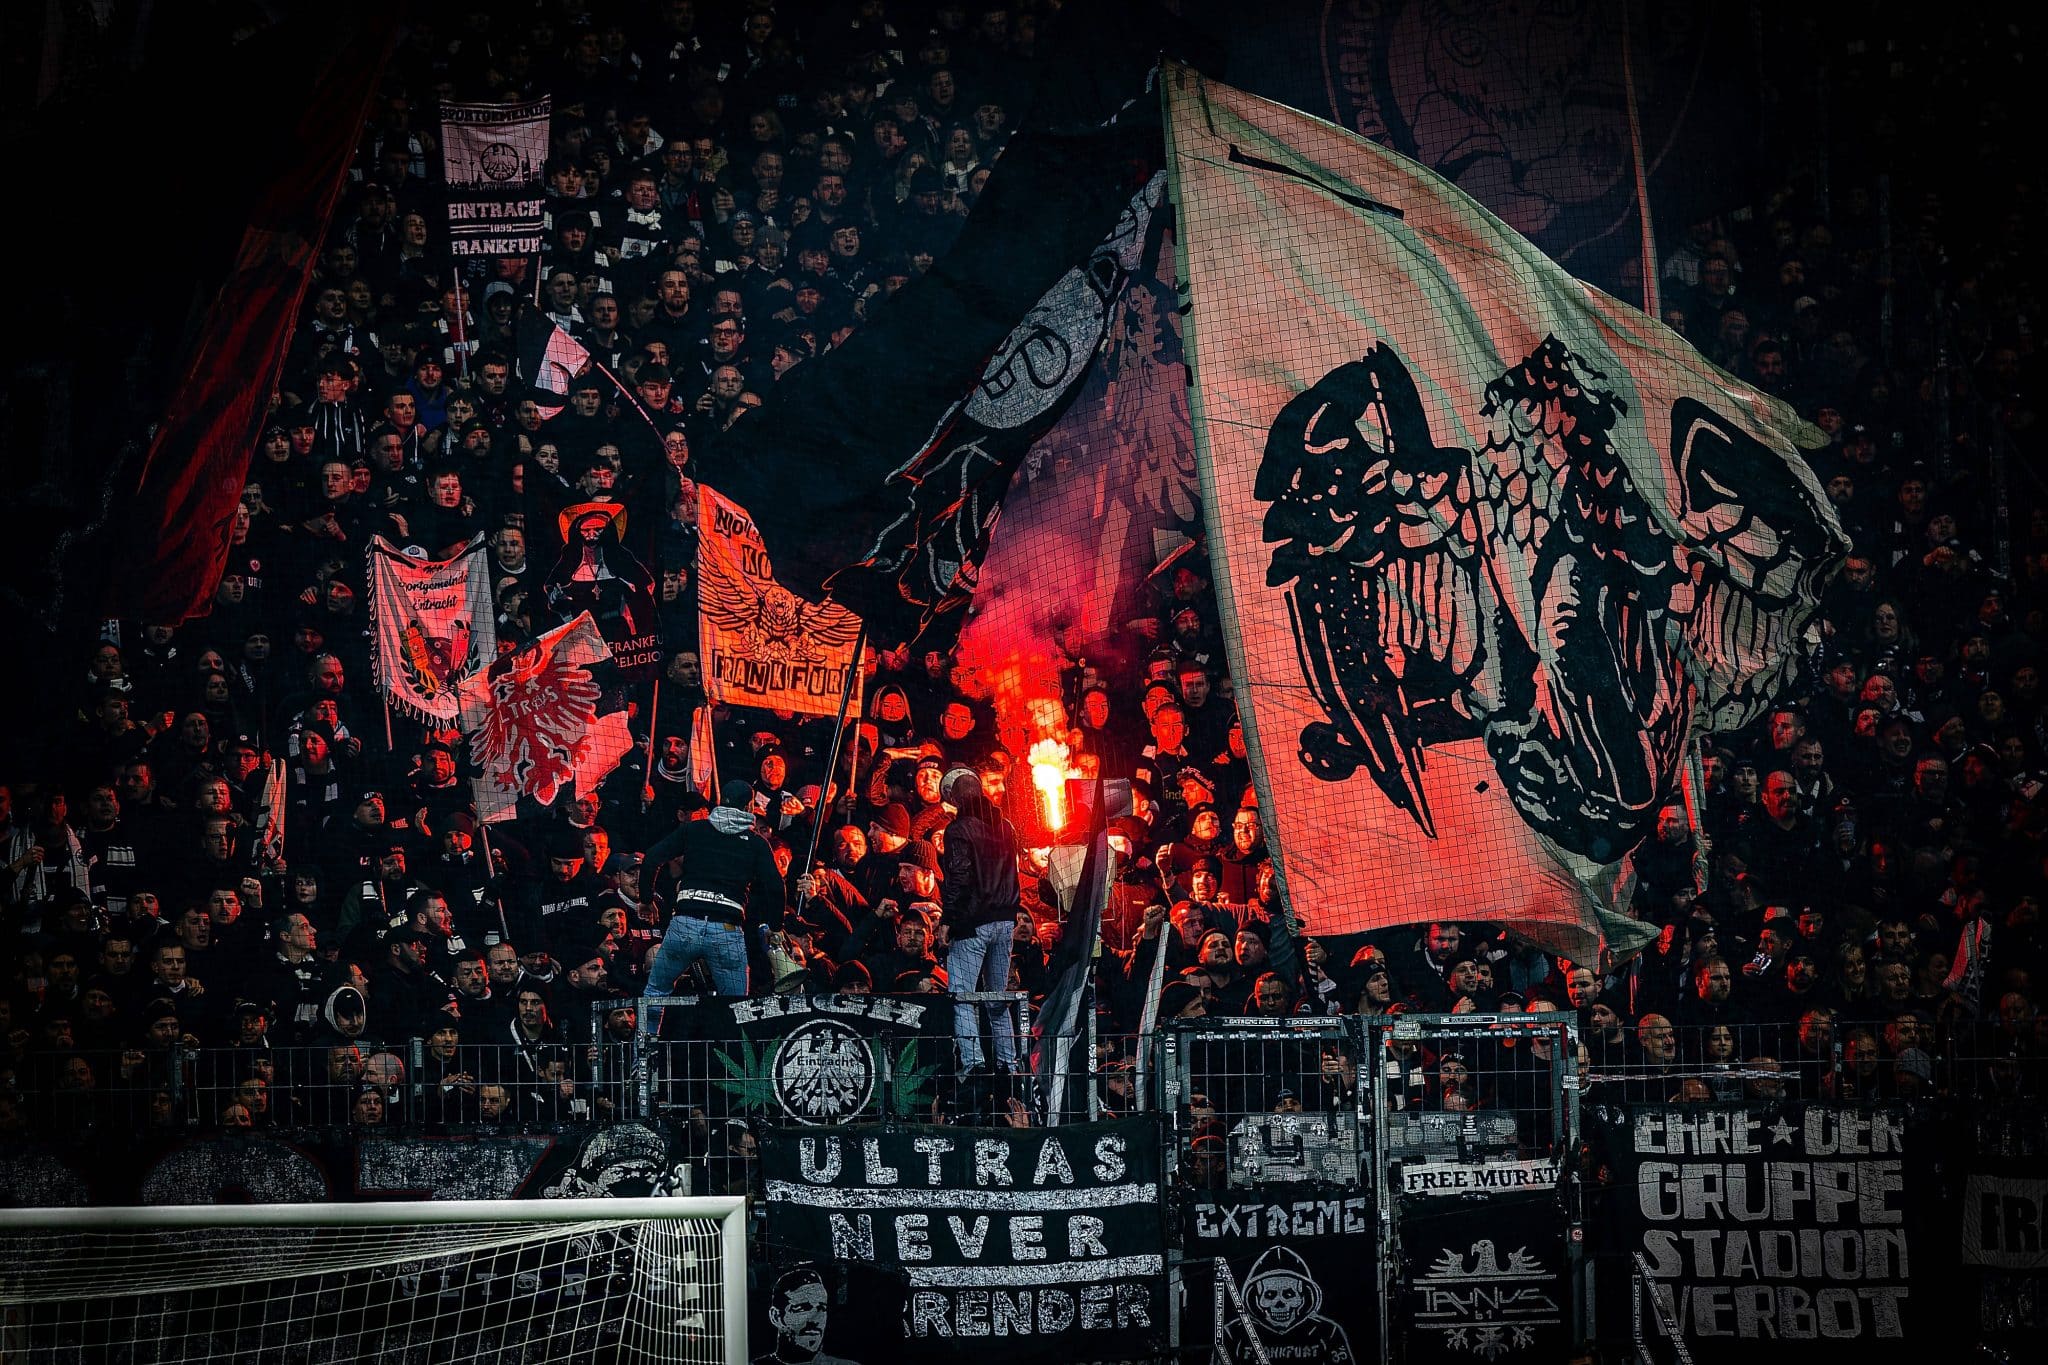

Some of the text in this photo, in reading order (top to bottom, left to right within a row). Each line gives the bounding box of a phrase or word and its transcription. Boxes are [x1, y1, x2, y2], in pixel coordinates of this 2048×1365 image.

[448, 199, 546, 220] EINTRACH
[451, 235, 544, 255] FRANKFUR
[729, 992, 927, 1030] HIGH
[797, 1055, 858, 1068] Eintracht
[1633, 1109, 1763, 1156] EHRE
[799, 1134, 1127, 1187] ULTRAS
[1407, 1166, 1560, 1191] FREE MURAT
[1638, 1159, 1904, 1225] GRUPPE
[829, 1212, 1109, 1262] NEVER
[1195, 1196, 1367, 1239] EXTREME
[1642, 1228, 1910, 1281] STADION
[1654, 1284, 1910, 1340] VERBOT
[1243, 1343, 1320, 1360] FANKFURT
